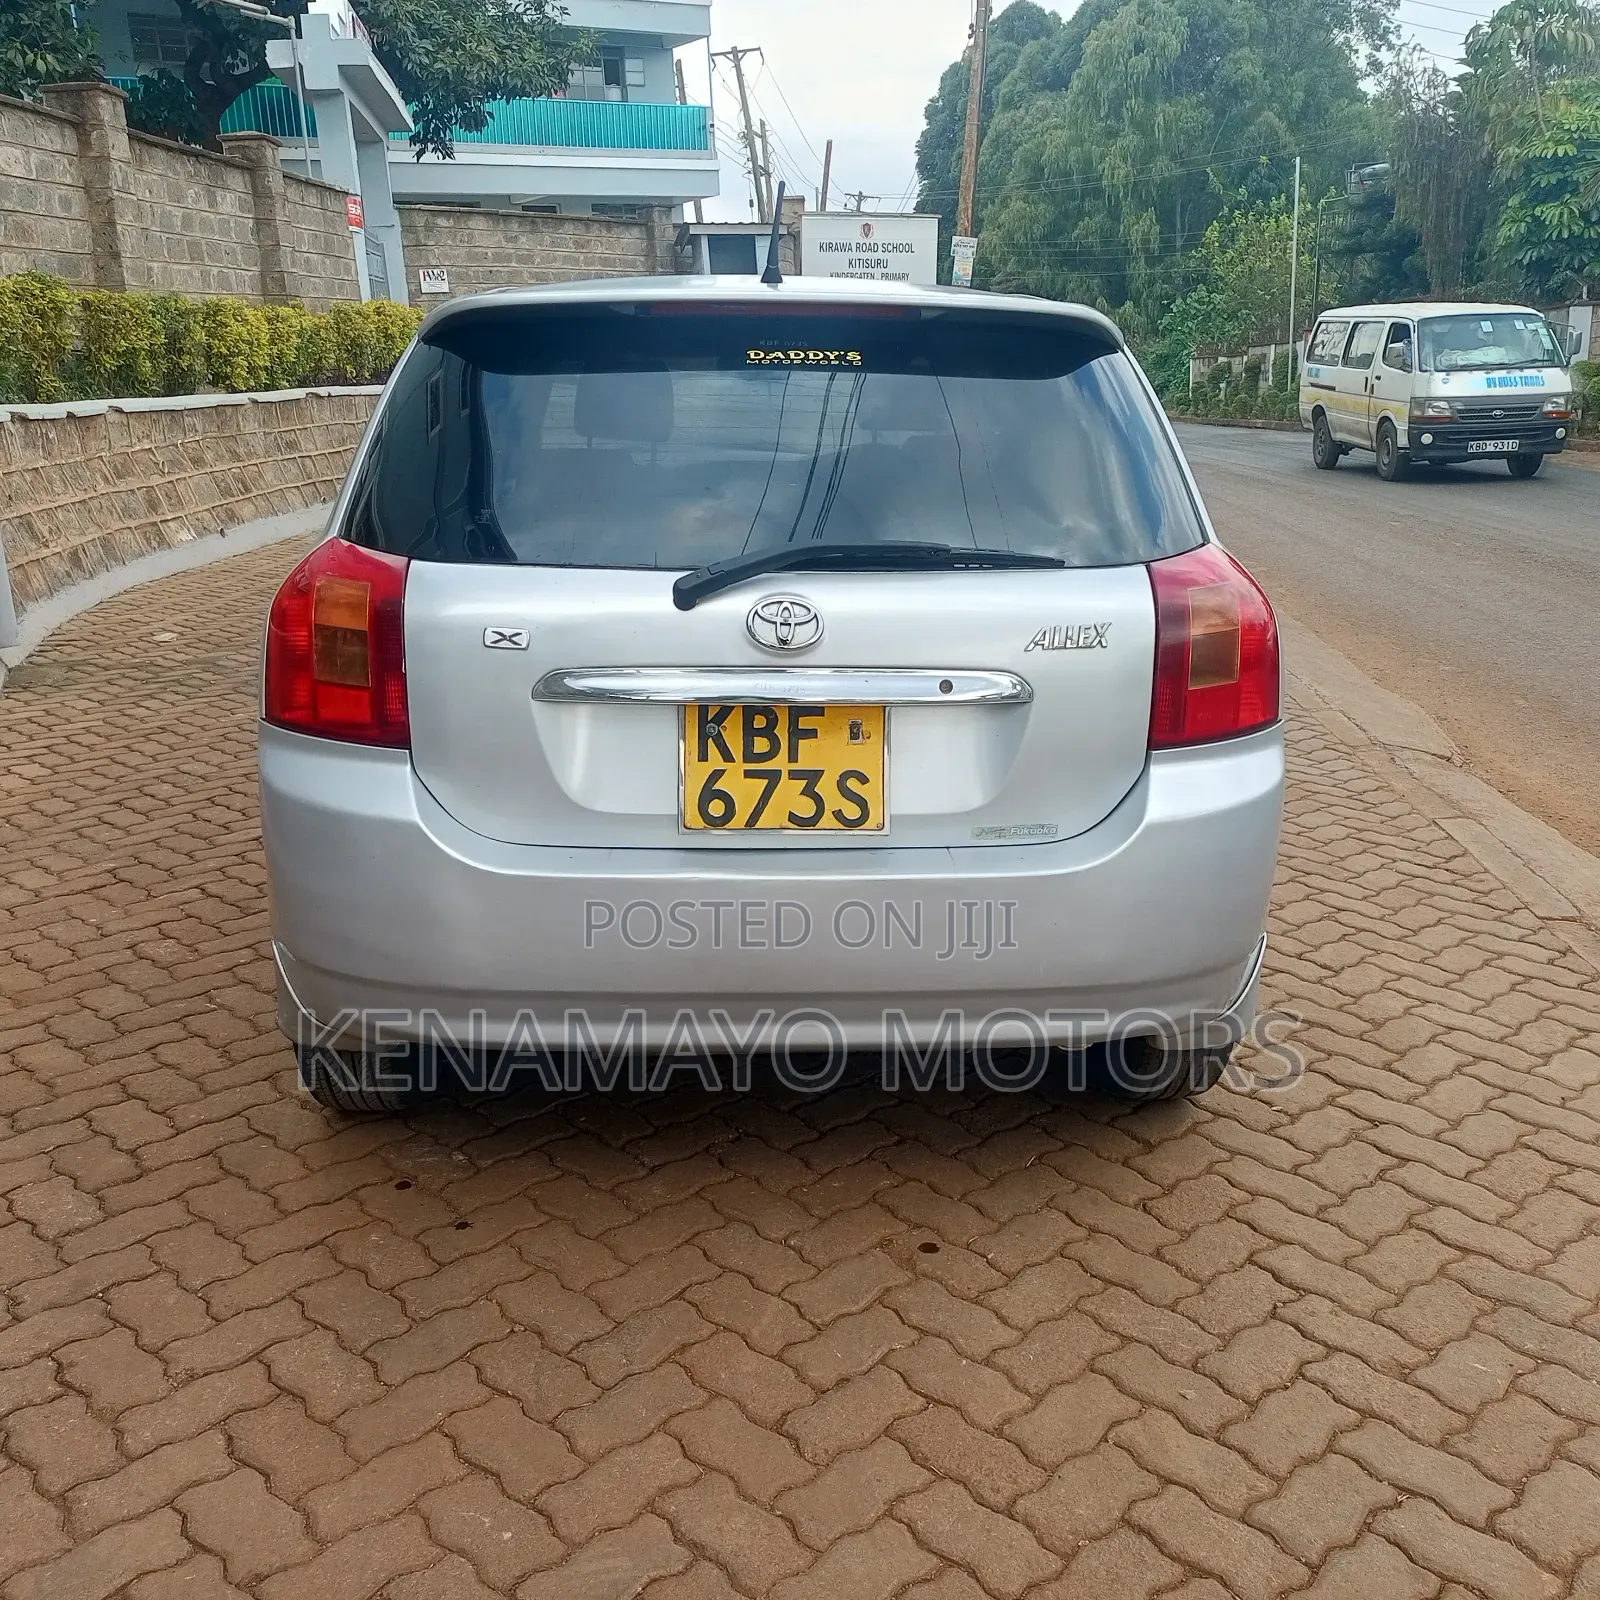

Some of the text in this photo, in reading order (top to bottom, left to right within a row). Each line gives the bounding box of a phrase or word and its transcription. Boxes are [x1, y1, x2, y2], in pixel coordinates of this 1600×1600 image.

[819, 242, 915, 254] KIRAWA ROAD SCHOOL
[848, 258, 889, 269] KITISURU
[746, 350, 862, 361] DADDY'S
[489, 630, 523, 647] X
[1024, 621, 1112, 652] ALLEX
[697, 704, 826, 764] KBF
[697, 769, 871, 828] 673S
[1010, 825, 1057, 837] Fukuoka
